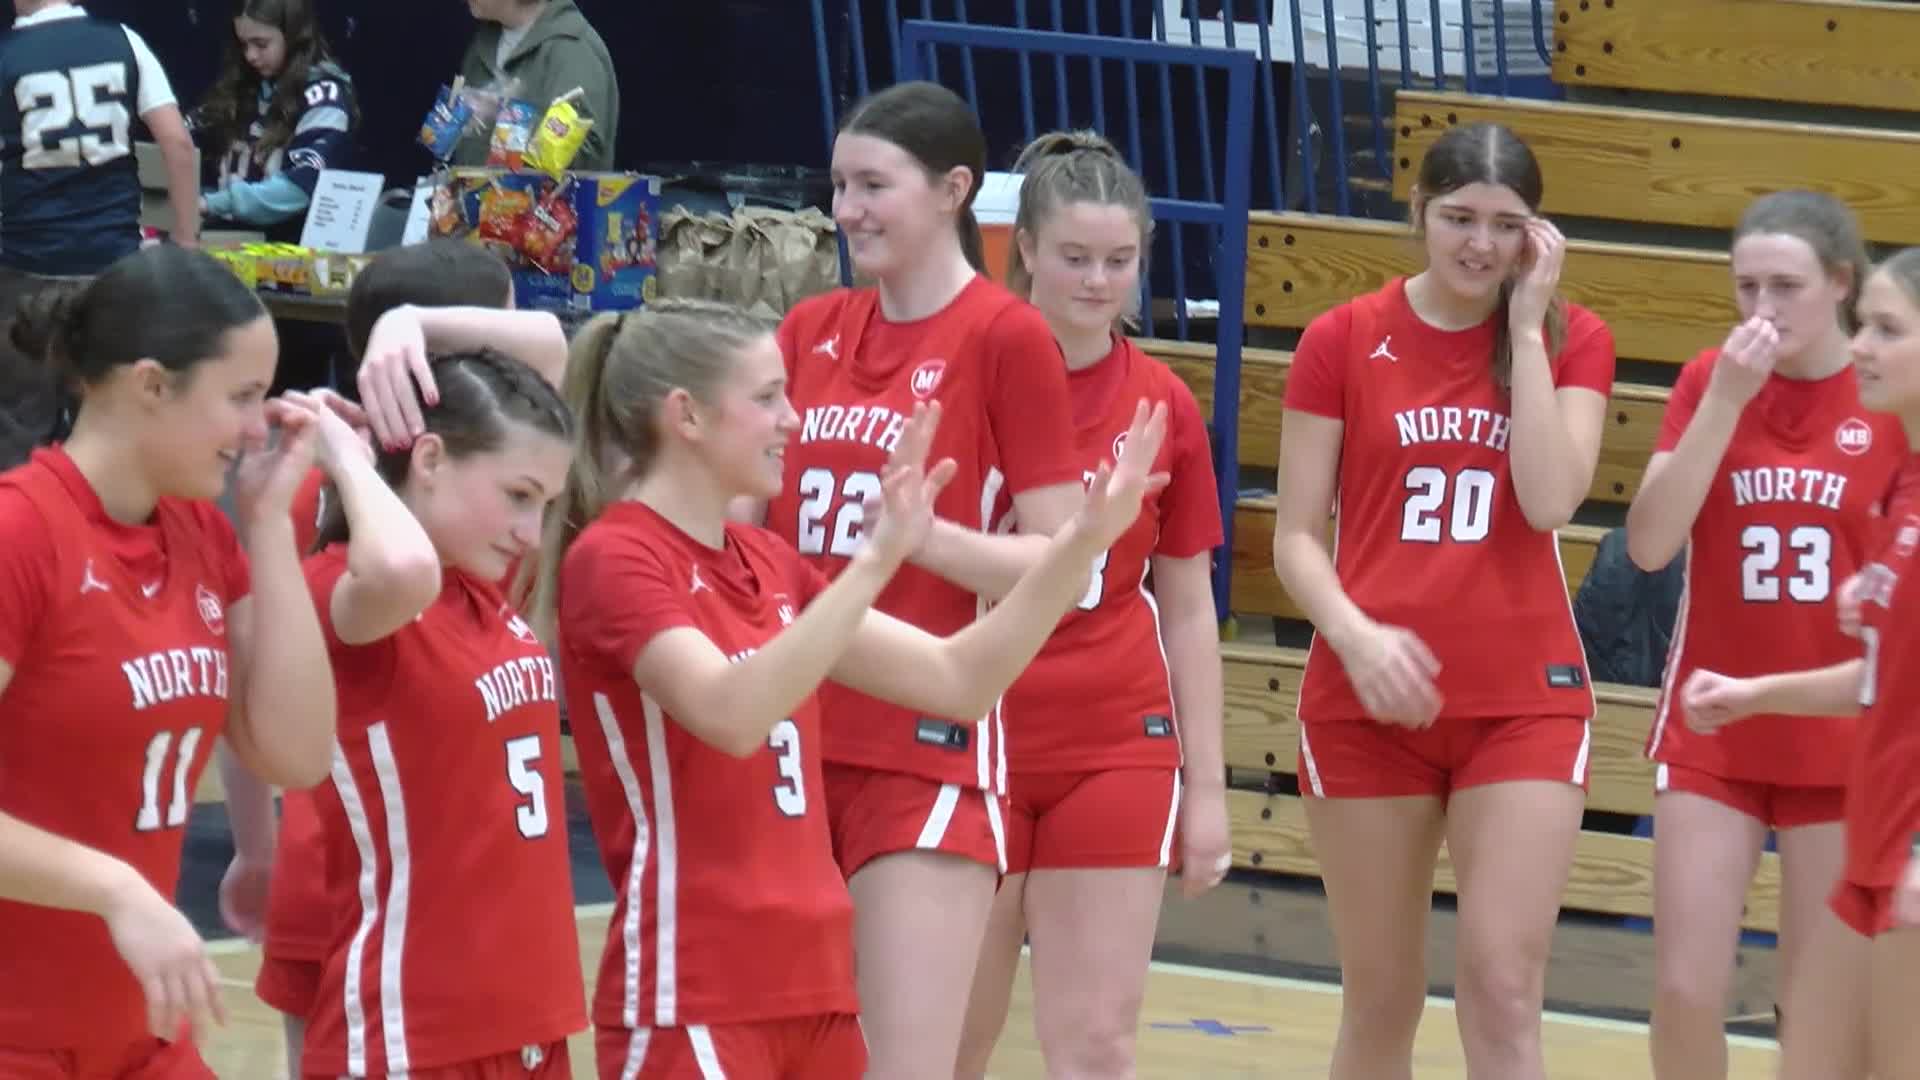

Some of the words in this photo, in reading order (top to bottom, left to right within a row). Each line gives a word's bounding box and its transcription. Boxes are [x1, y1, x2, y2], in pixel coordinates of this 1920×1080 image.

[13, 61, 130, 169] 25
[801, 405, 905, 452] NORTH
[1394, 407, 1511, 451] NORTH
[1840, 429, 1868, 445] MB
[799, 467, 882, 556] 22
[1401, 466, 1496, 543] 20
[1731, 467, 1847, 510] NORTH
[1741, 526, 1831, 602] 23
[121, 647, 229, 710] NORTH
[475, 656, 556, 722] NORTH
[136, 727, 203, 830] 11
[506, 735, 548, 839] 5
[768, 719, 807, 817] 3
